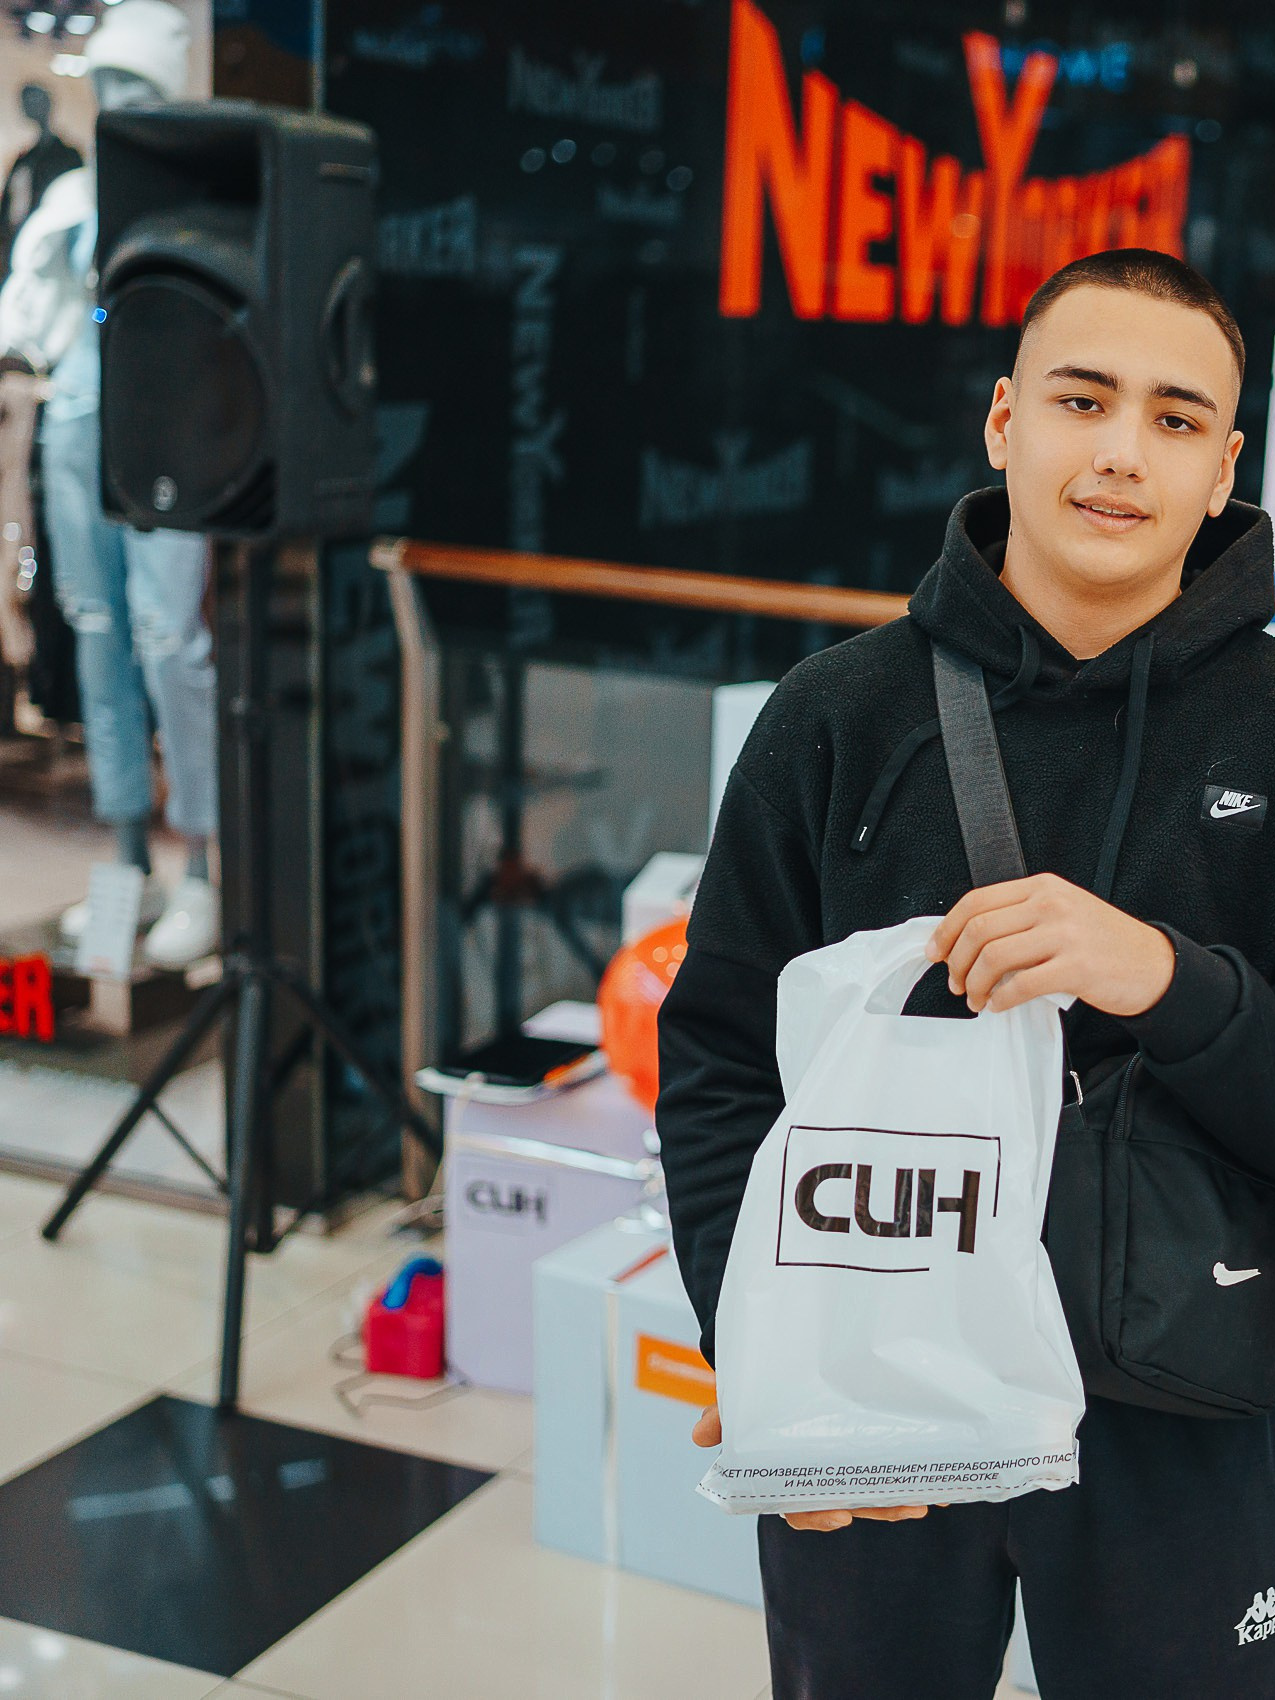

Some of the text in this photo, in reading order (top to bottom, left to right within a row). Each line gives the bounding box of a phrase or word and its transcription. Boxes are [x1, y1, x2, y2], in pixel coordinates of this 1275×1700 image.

[1219, 790, 1253, 808] NIKE
[718, 1467, 742, 1479] КЕТ
[743, 1467, 823, 1478] ПРОИЗВЕДЕН
[825, 1466, 836, 1476] С
[836, 1463, 927, 1476] ДОБАВЛЕНИЕМ
[929, 1456, 1041, 1472] ПЕРЕРАБОТАННОГО
[784, 1472, 999, 1488] И НА 100% ПОДЛЕЖИТ ПЕРЕРАБОТКЕ
